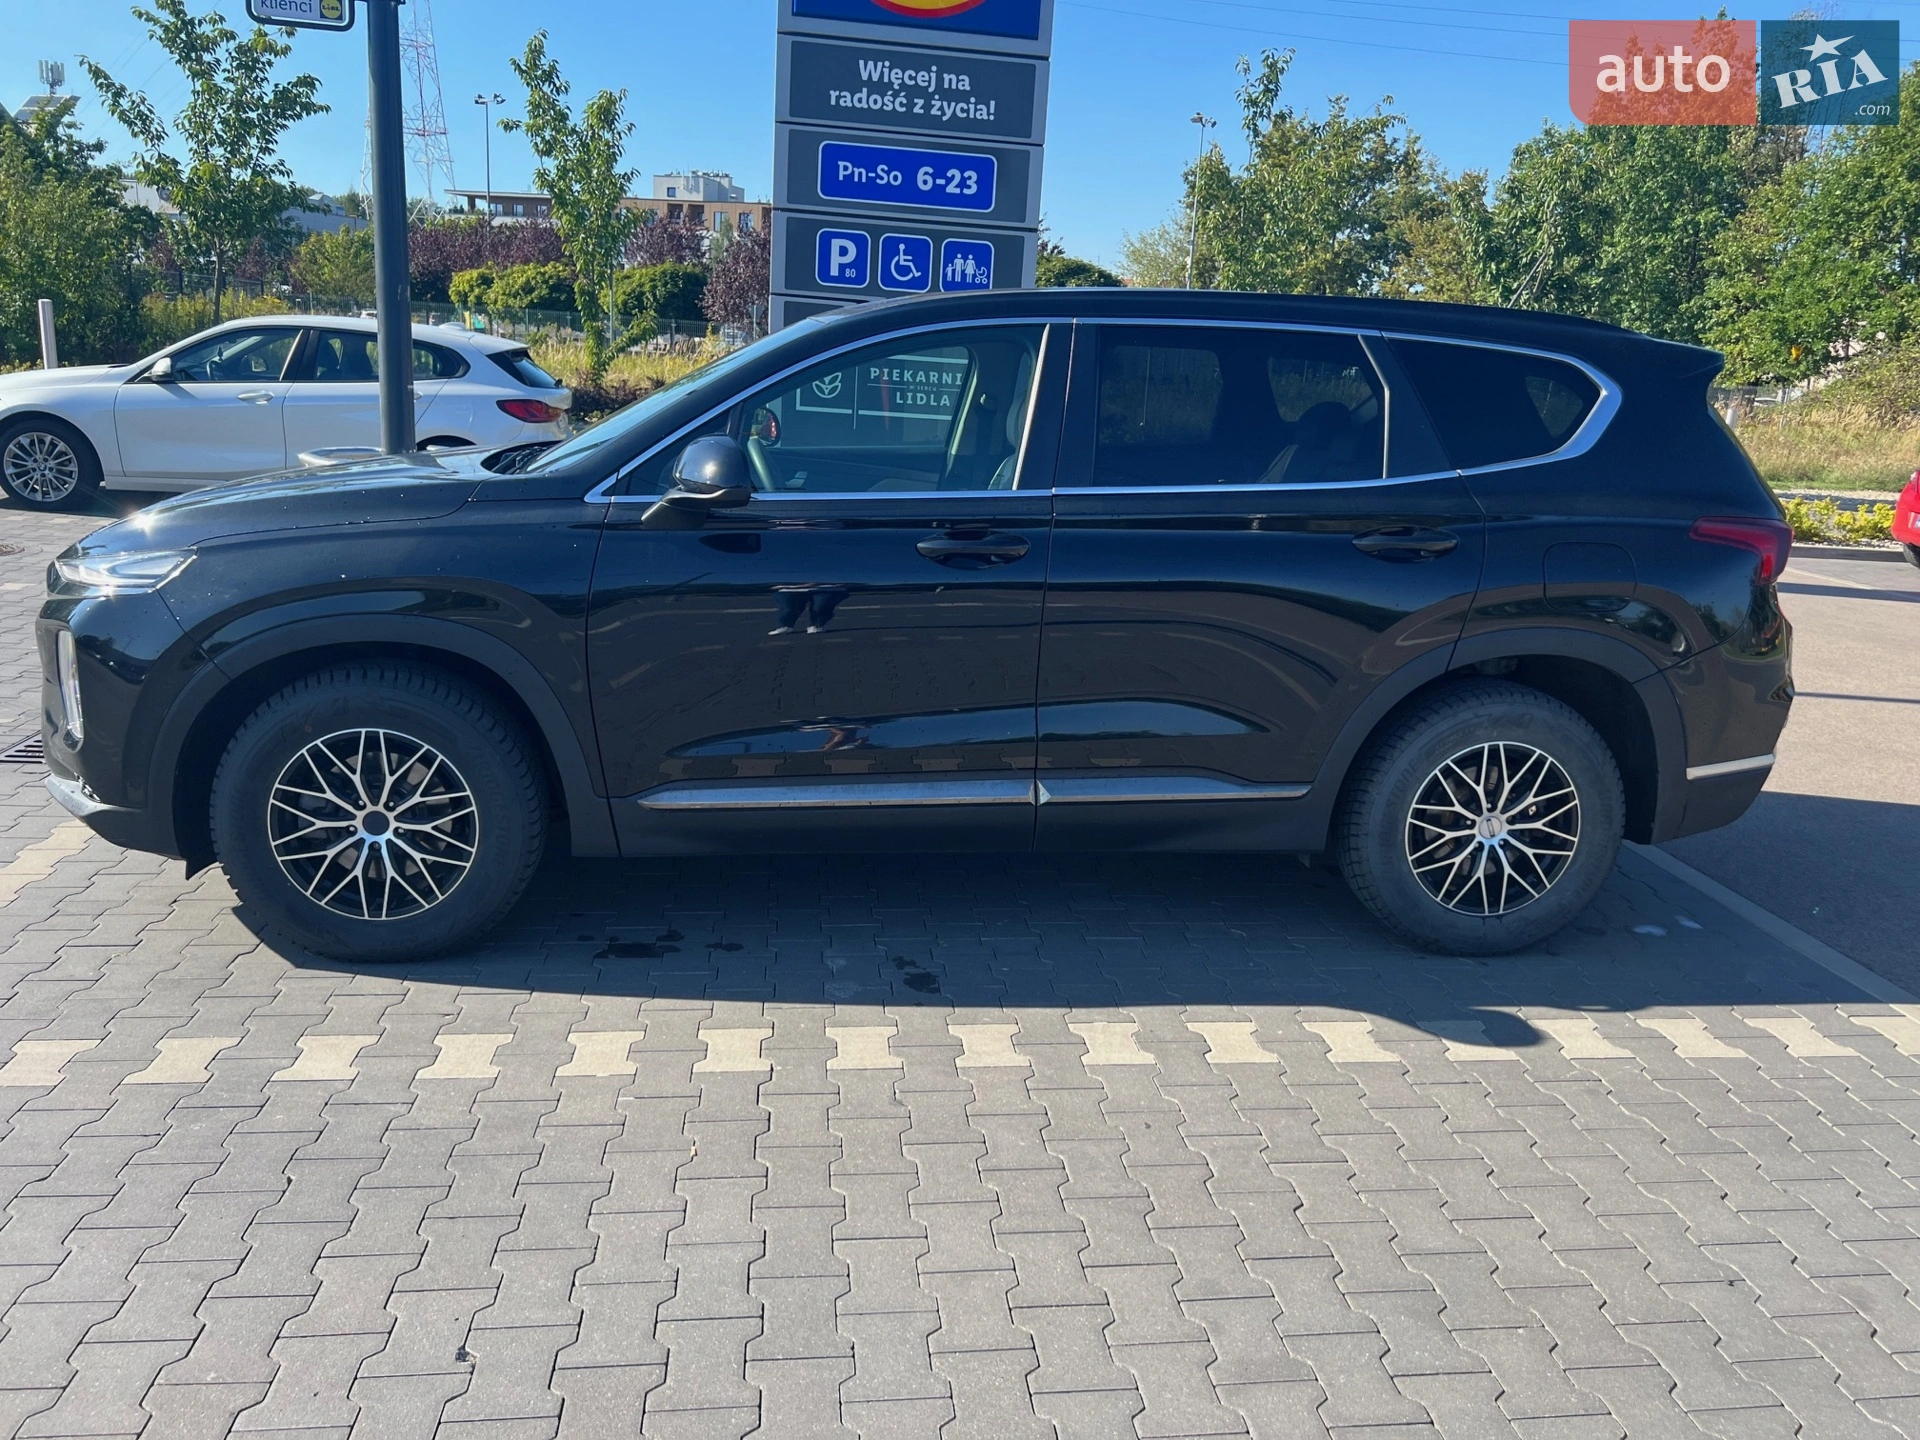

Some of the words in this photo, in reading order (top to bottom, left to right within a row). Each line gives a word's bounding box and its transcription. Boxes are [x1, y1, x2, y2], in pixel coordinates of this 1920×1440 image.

[858, 59, 937, 92] Więcej
[943, 71, 971, 91] na
[829, 88, 907, 112] radość
[913, 97, 925, 114] z
[930, 95, 996, 121] życia!
[837, 160, 903, 186] Pn-So
[916, 166, 978, 195] 6-23
[829, 238, 857, 277] P
[844, 267, 856, 278] 80
[896, 391, 950, 407] LIDLA
